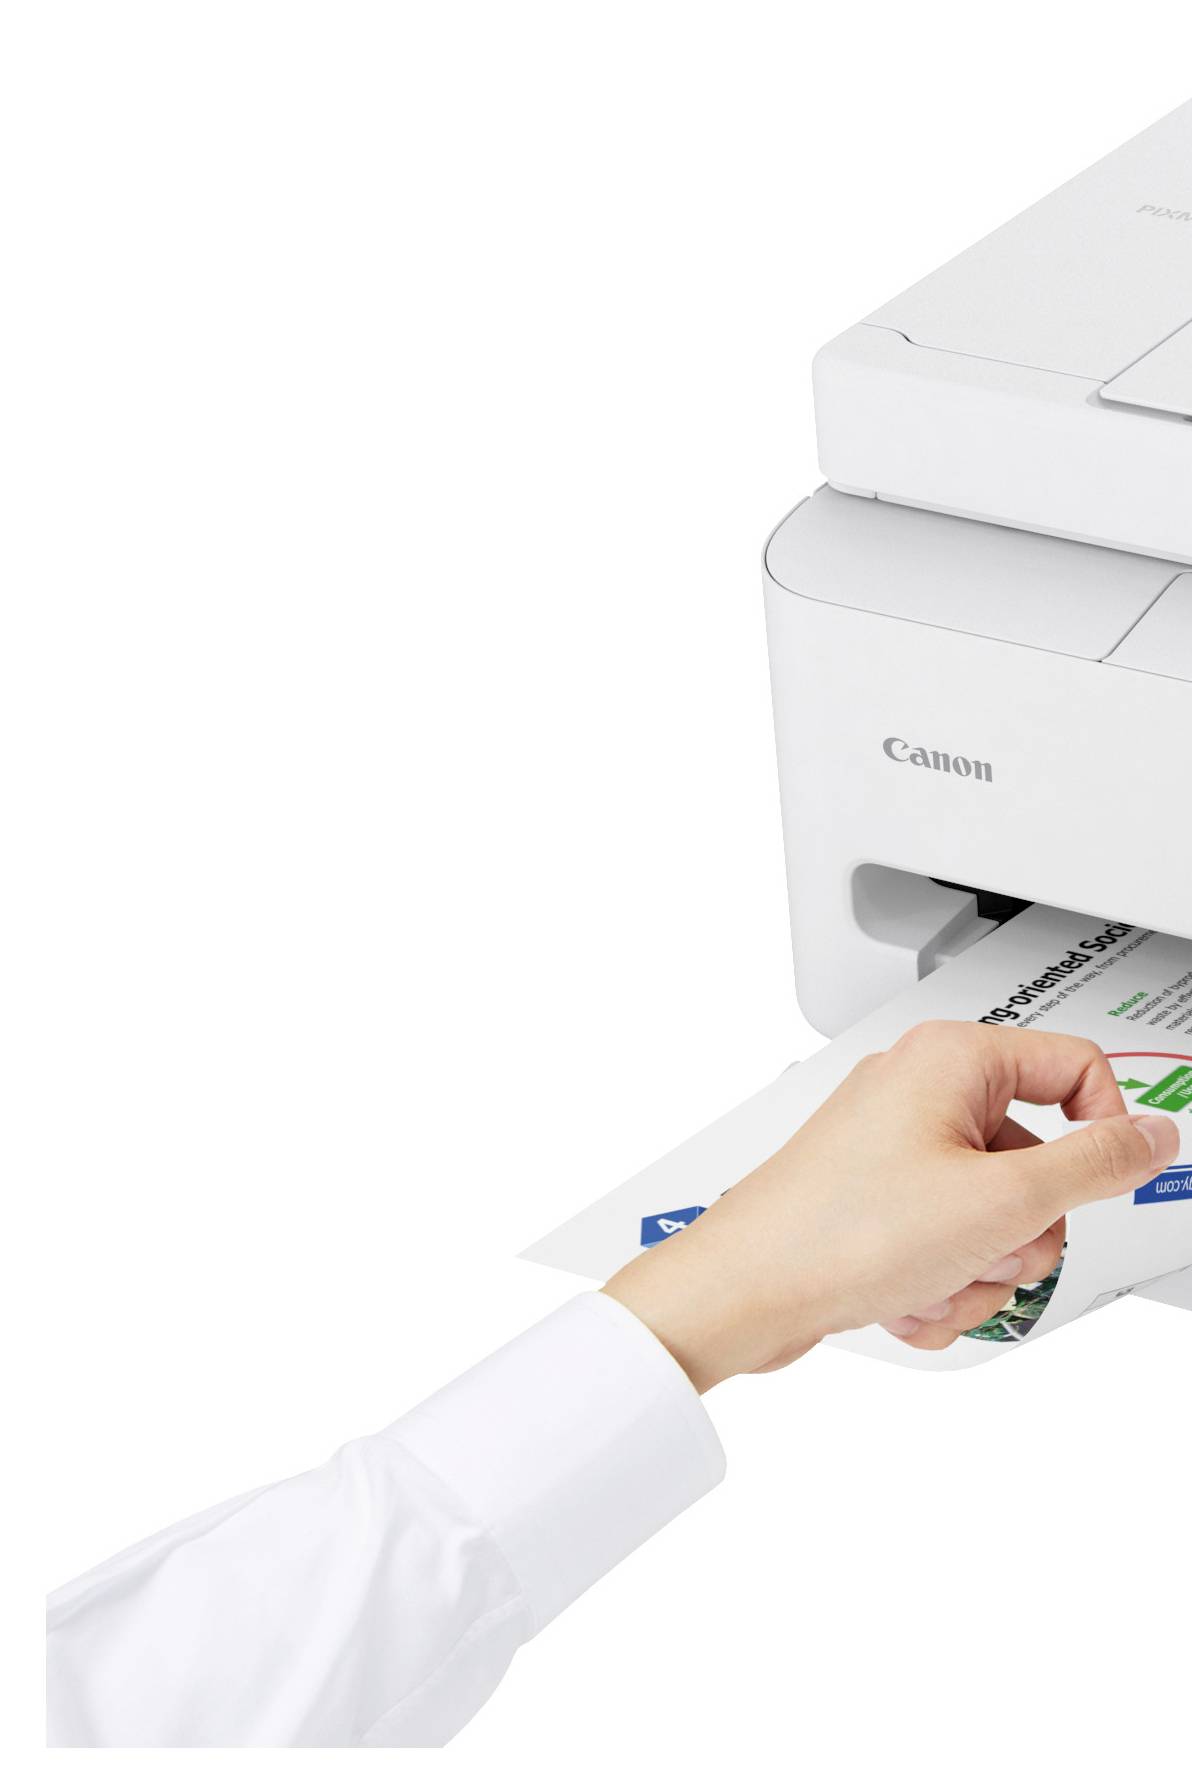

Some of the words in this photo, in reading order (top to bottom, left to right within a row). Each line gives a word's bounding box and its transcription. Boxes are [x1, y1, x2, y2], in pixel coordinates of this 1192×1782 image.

[882, 737, 993, 783] Canon
[1017, 1011, 1044, 1028] every
[1039, 998, 1061, 1013] step
[1056, 990, 1069, 1001] of
[1064, 981, 1084, 993] the
[1096, 956, 1120, 971] from
[1108, 991, 1149, 1017] Reduce
[1126, 995, 1165, 1021] Reduction
[1162, 988, 1173, 998] of
[1147, 1009, 1172, 1026] waste
[1168, 1002, 1183, 1012] by
[657, 1218, 688, 1234] 4
